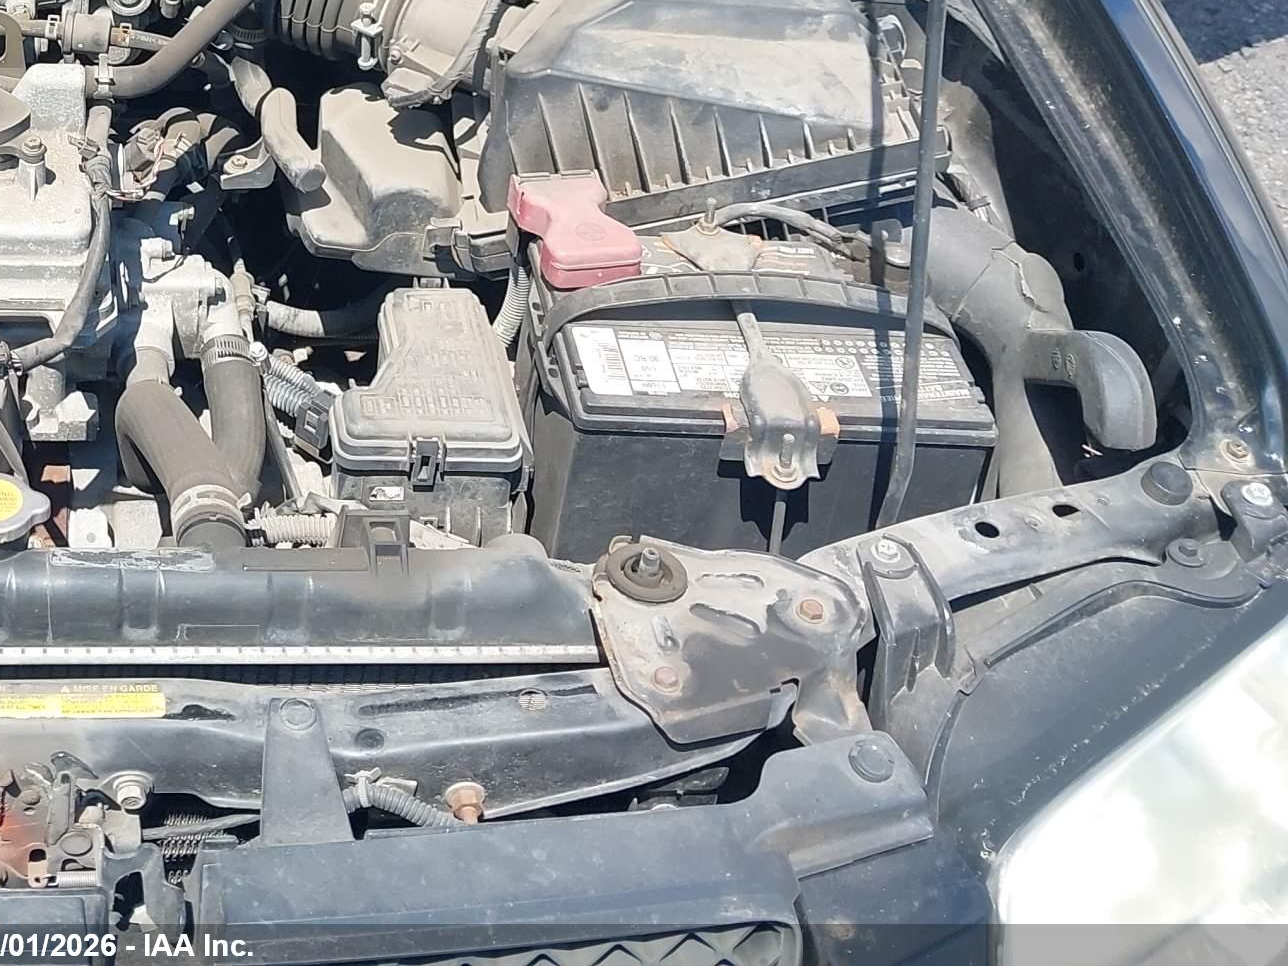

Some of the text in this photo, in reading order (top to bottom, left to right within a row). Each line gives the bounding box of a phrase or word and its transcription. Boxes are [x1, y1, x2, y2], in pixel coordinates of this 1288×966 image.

[73, 684, 159, 694] MISE EN GARDE
